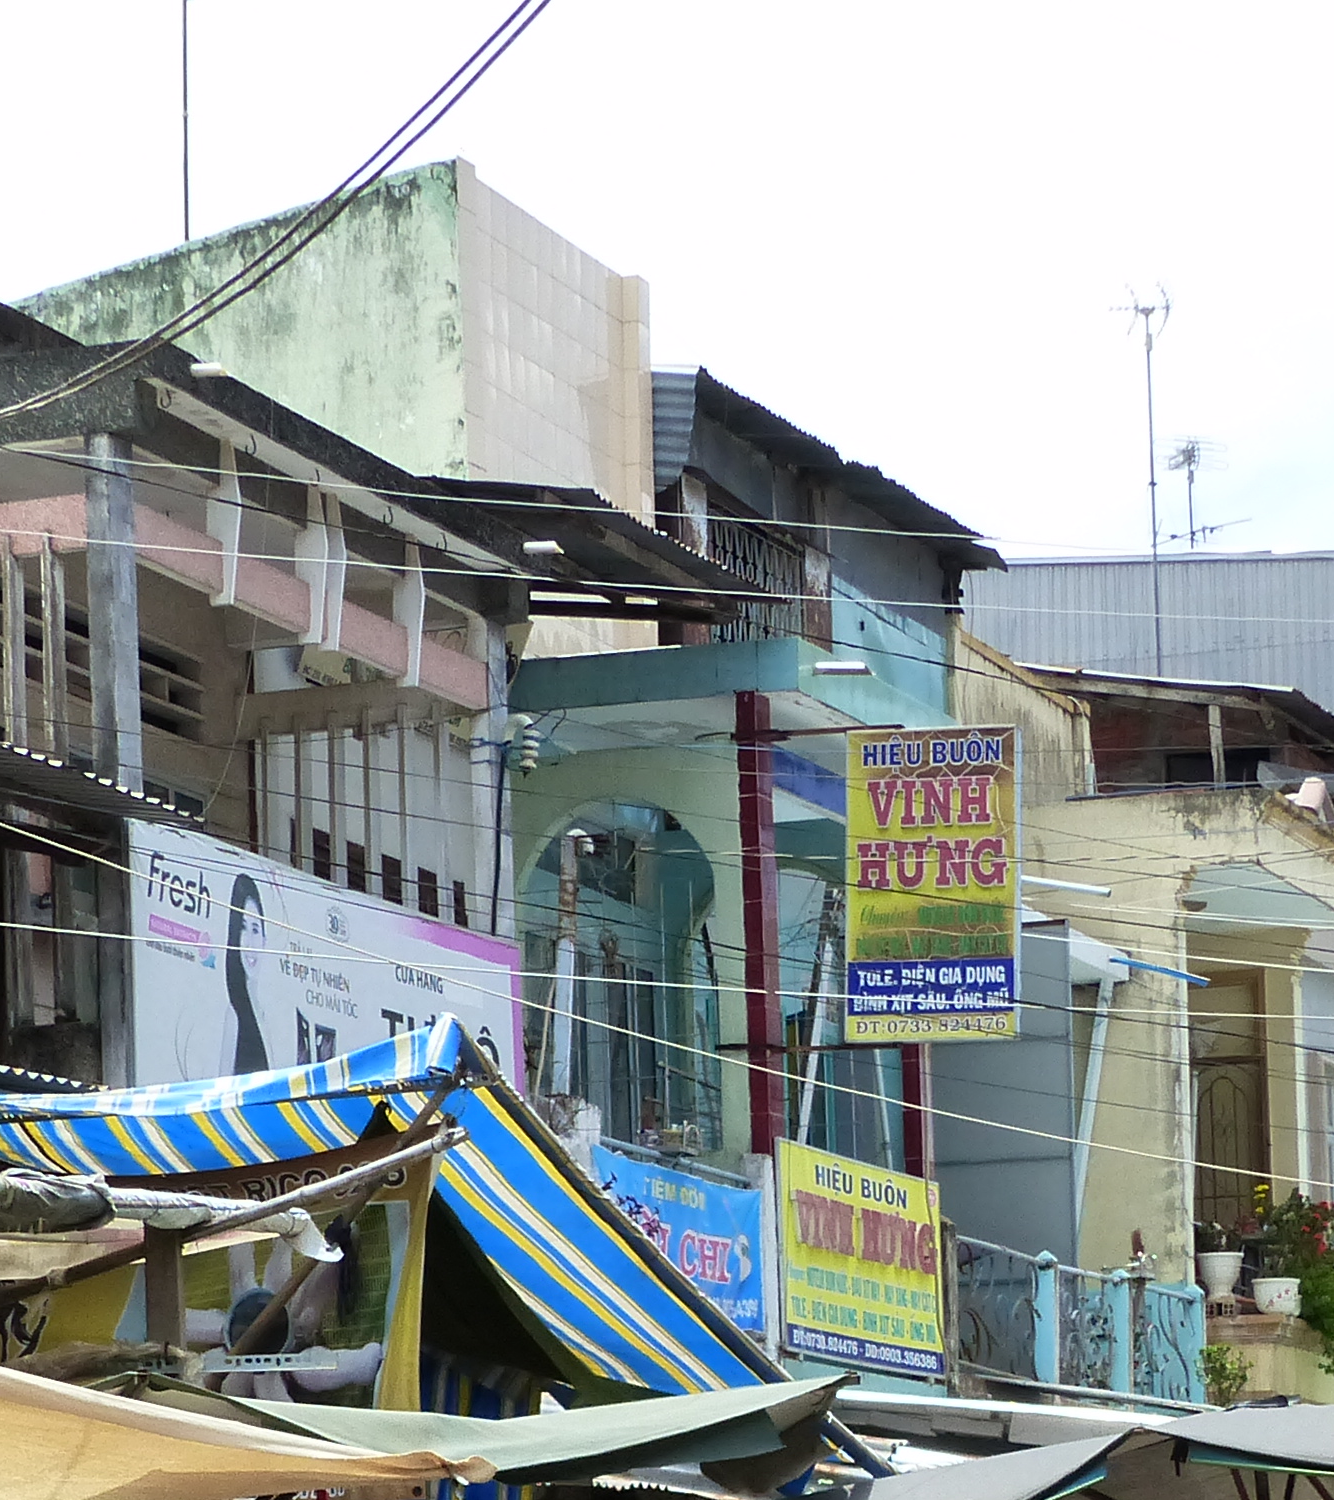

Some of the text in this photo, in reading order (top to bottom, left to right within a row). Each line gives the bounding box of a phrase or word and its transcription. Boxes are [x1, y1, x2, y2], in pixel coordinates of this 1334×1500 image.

[862, 731, 1001, 774] HIỆU BUÔN
[867, 775, 992, 828] VINH
[147, 851, 211, 919] Fresh
[857, 835, 1007, 889] HƯNG
[939, 967, 962, 985] GIA
[967, 966, 1005, 986] DỤNG
[815, 1162, 853, 1196] HIỆU
[861, 1178, 907, 1210] BUÔN
